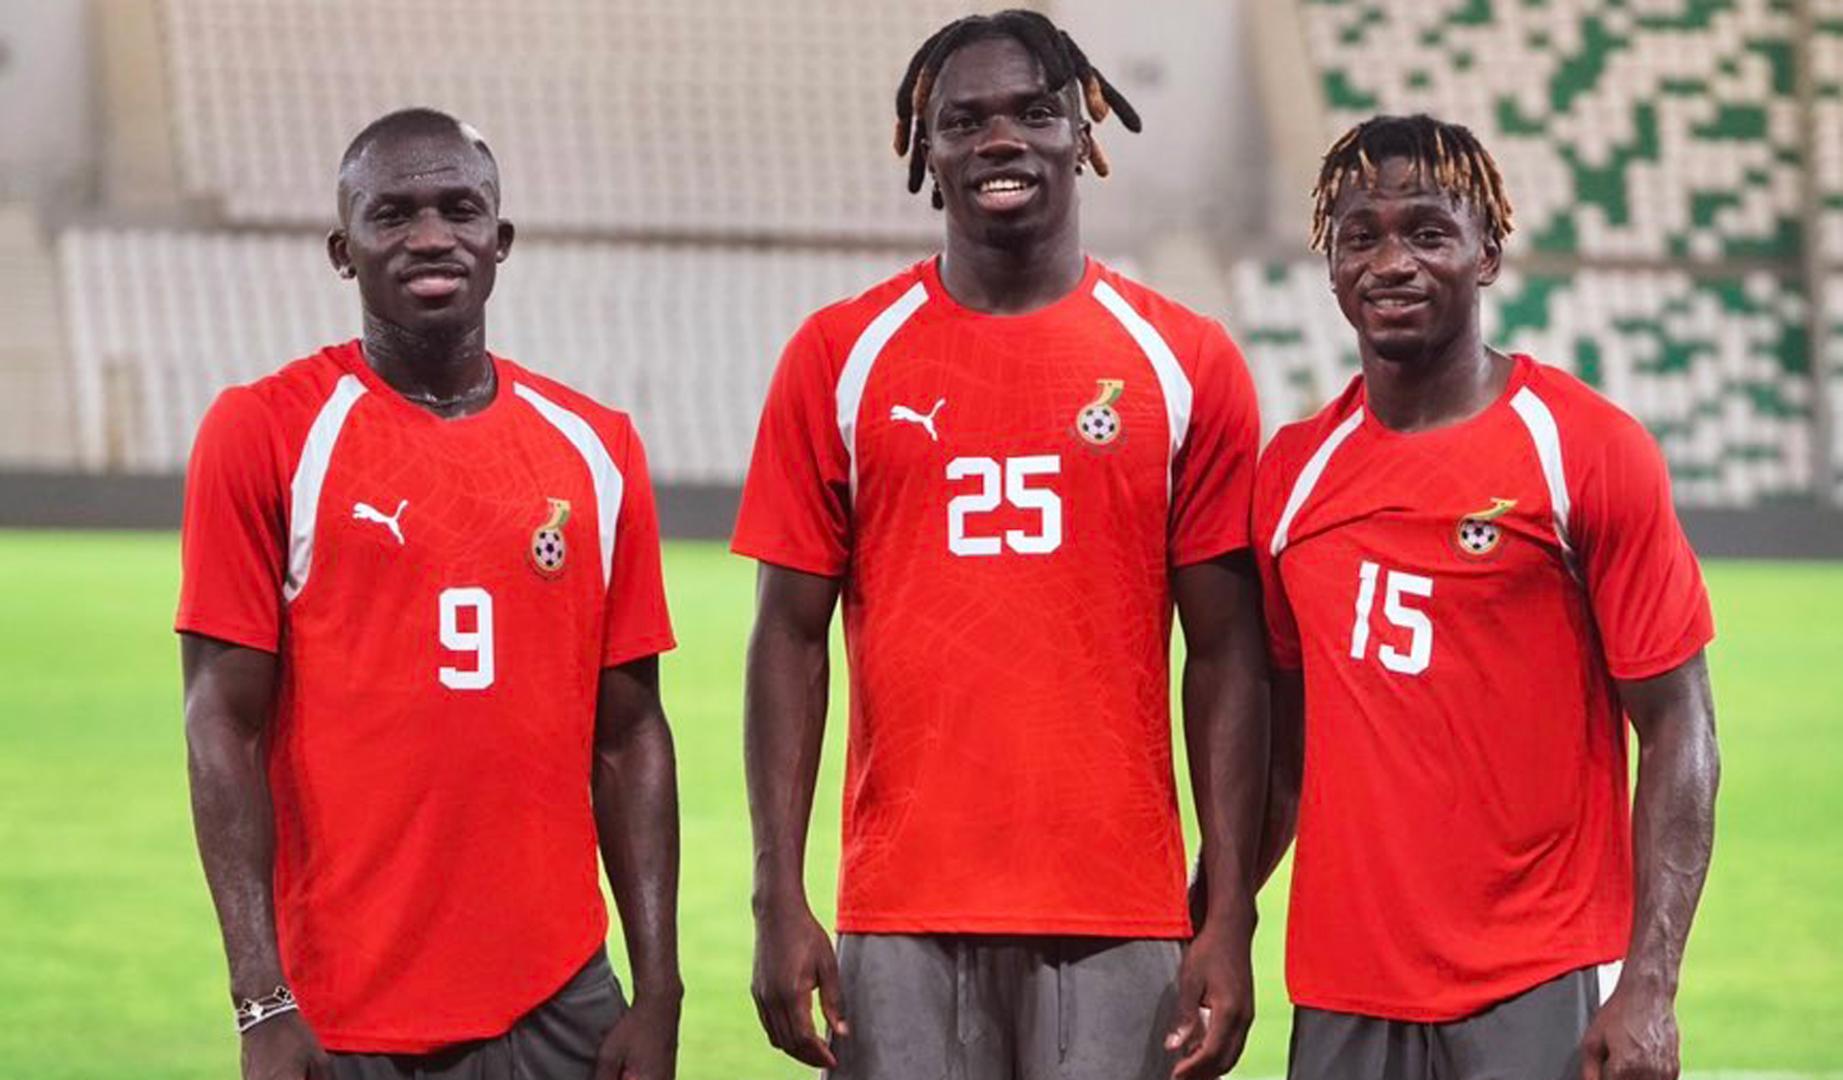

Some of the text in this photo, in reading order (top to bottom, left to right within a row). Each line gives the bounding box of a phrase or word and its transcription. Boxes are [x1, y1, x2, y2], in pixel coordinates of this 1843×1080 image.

[946, 454, 1063, 557] 25
[438, 587, 495, 691] 9
[1350, 561, 1433, 675] 15
